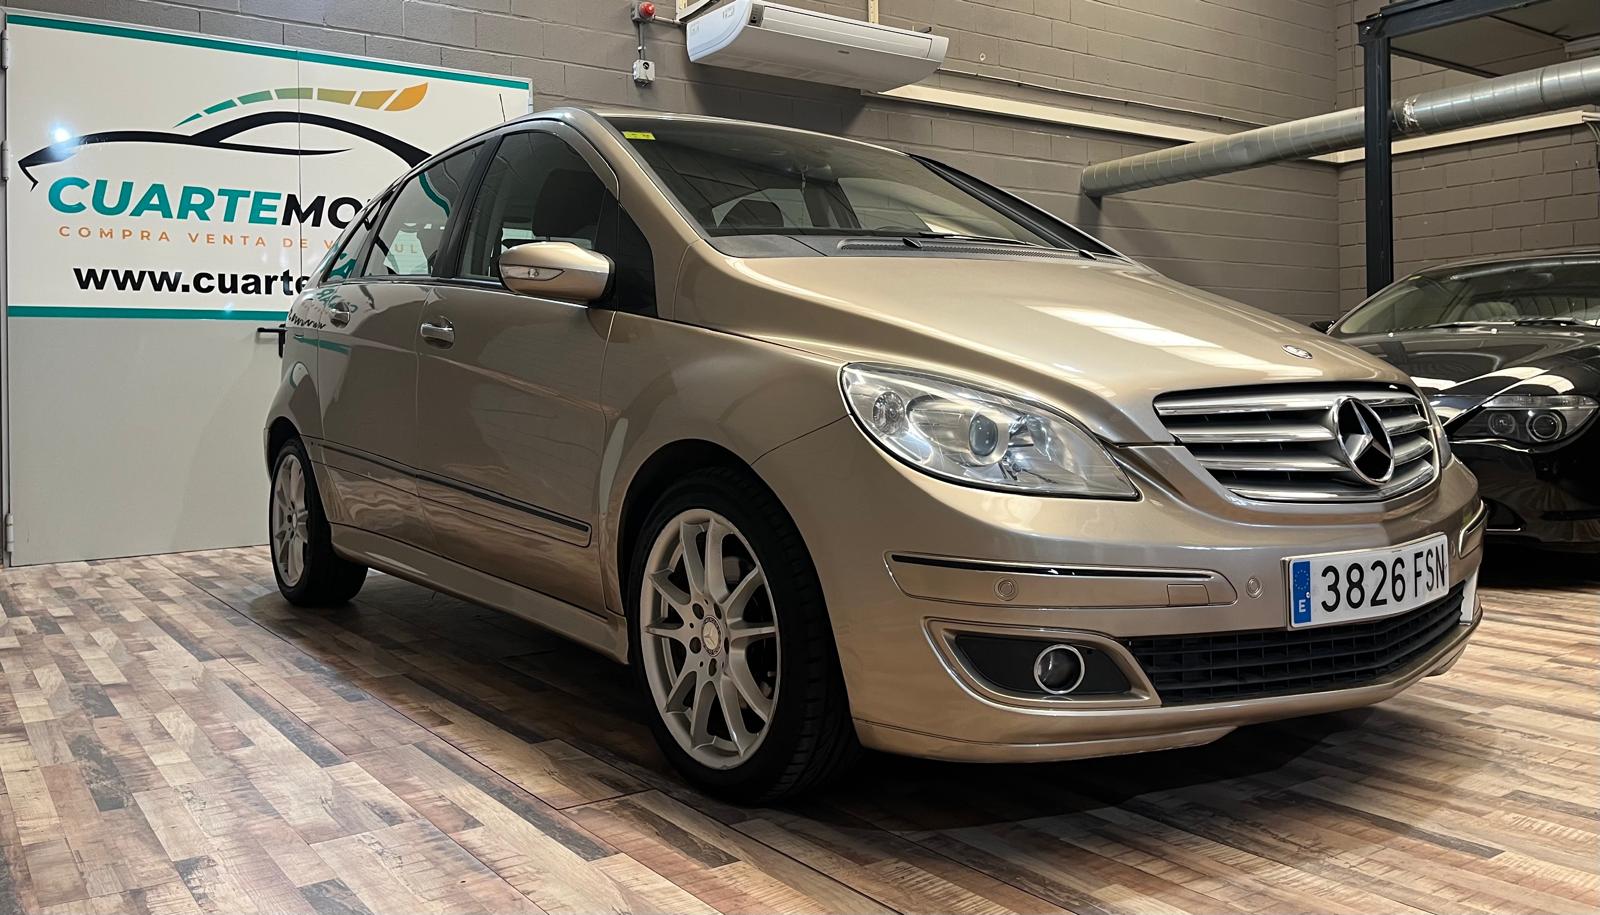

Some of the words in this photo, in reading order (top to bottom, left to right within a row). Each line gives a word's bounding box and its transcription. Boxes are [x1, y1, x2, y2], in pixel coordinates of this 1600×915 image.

[59, 226, 170, 242] COMPRA
[188, 233, 266, 247] VENTA
[283, 238, 308, 248] DE
[1321, 557, 1406, 612] 3826
[1413, 544, 1446, 597] FSN
[1298, 599, 1306, 613] E
